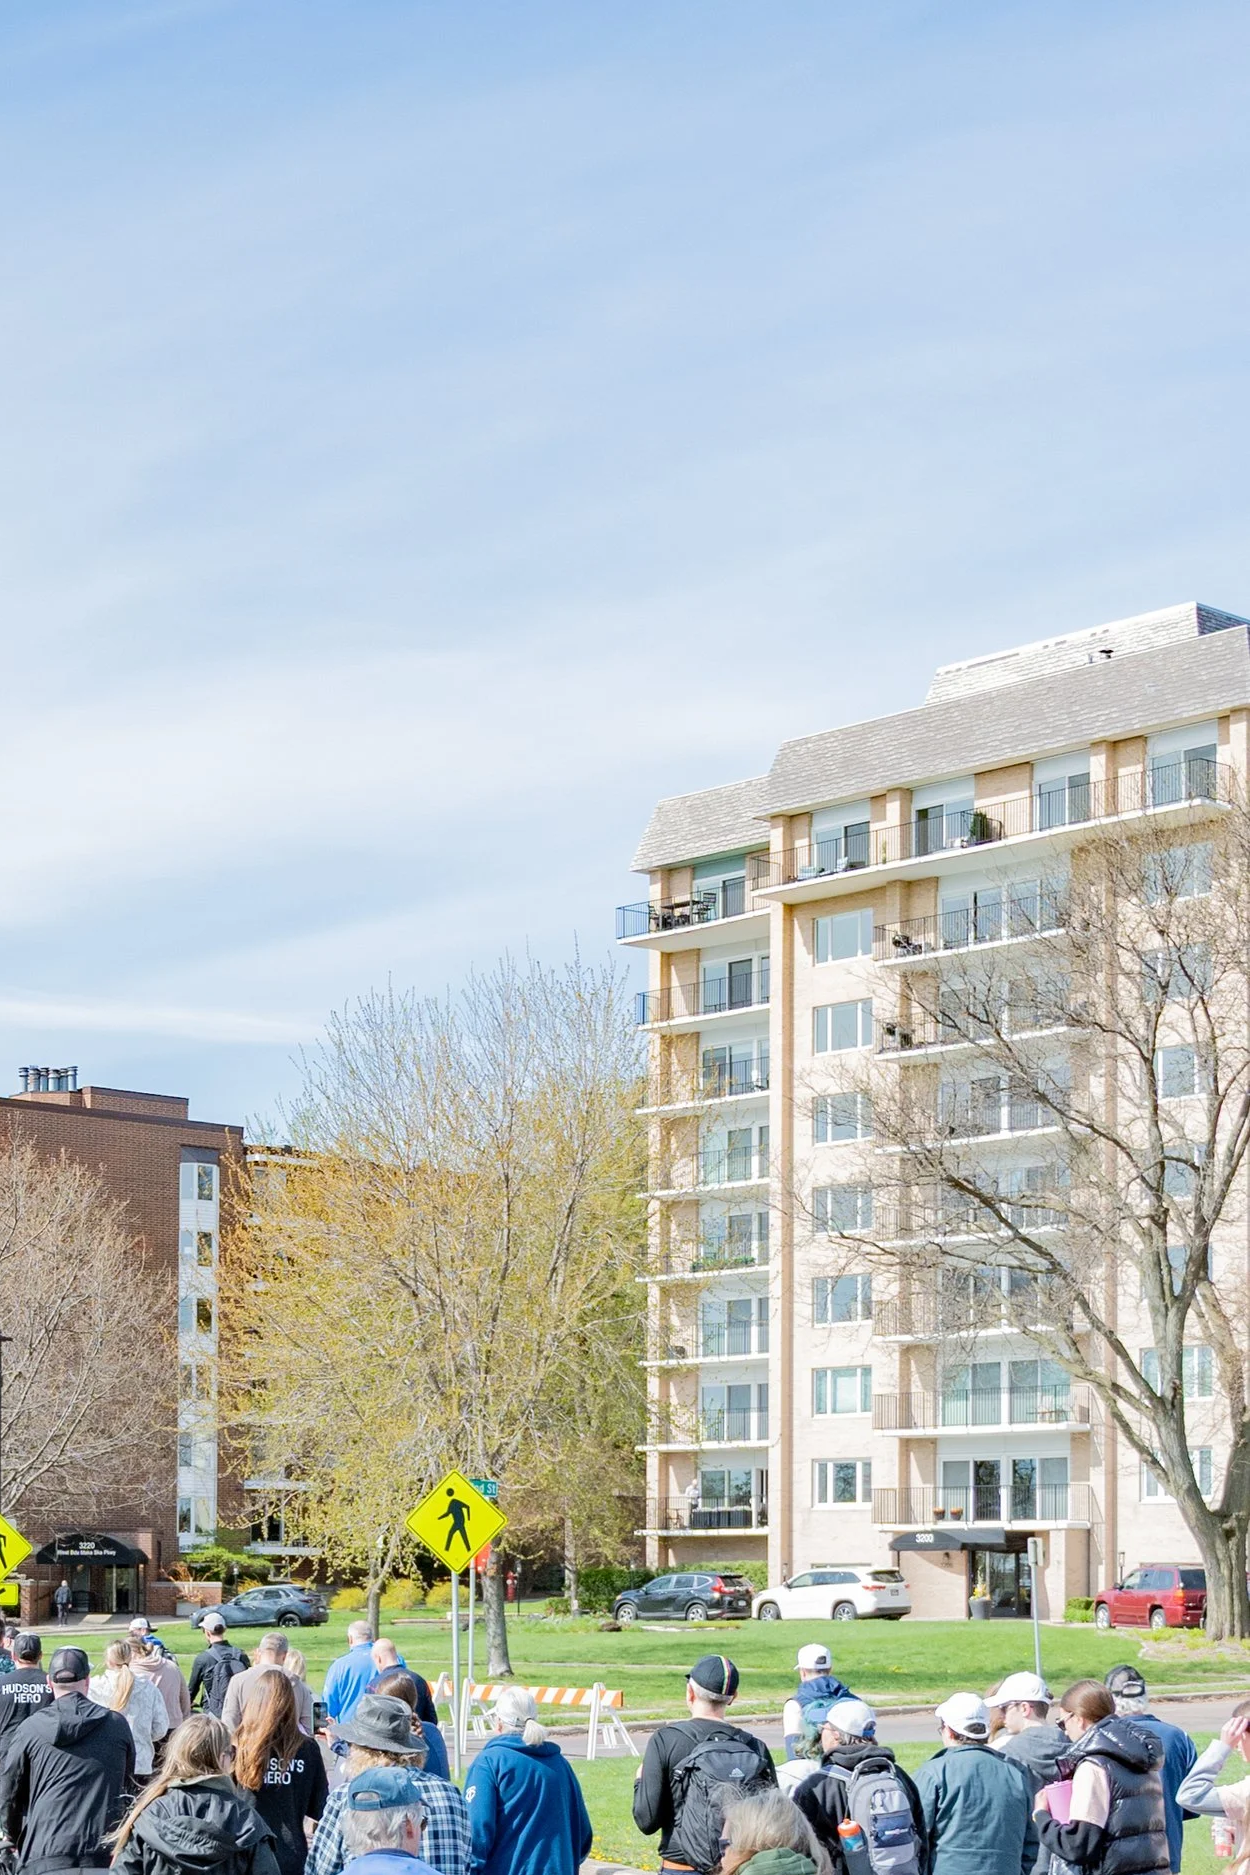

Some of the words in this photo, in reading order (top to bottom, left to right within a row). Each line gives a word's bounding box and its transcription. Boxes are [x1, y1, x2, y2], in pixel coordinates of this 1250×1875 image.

[487, 1484, 496, 1493] St
[915, 1534, 934, 1543] 3200
[2, 1684, 52, 1695] HUDSON'S
[14, 1693, 41, 1703] HERO
